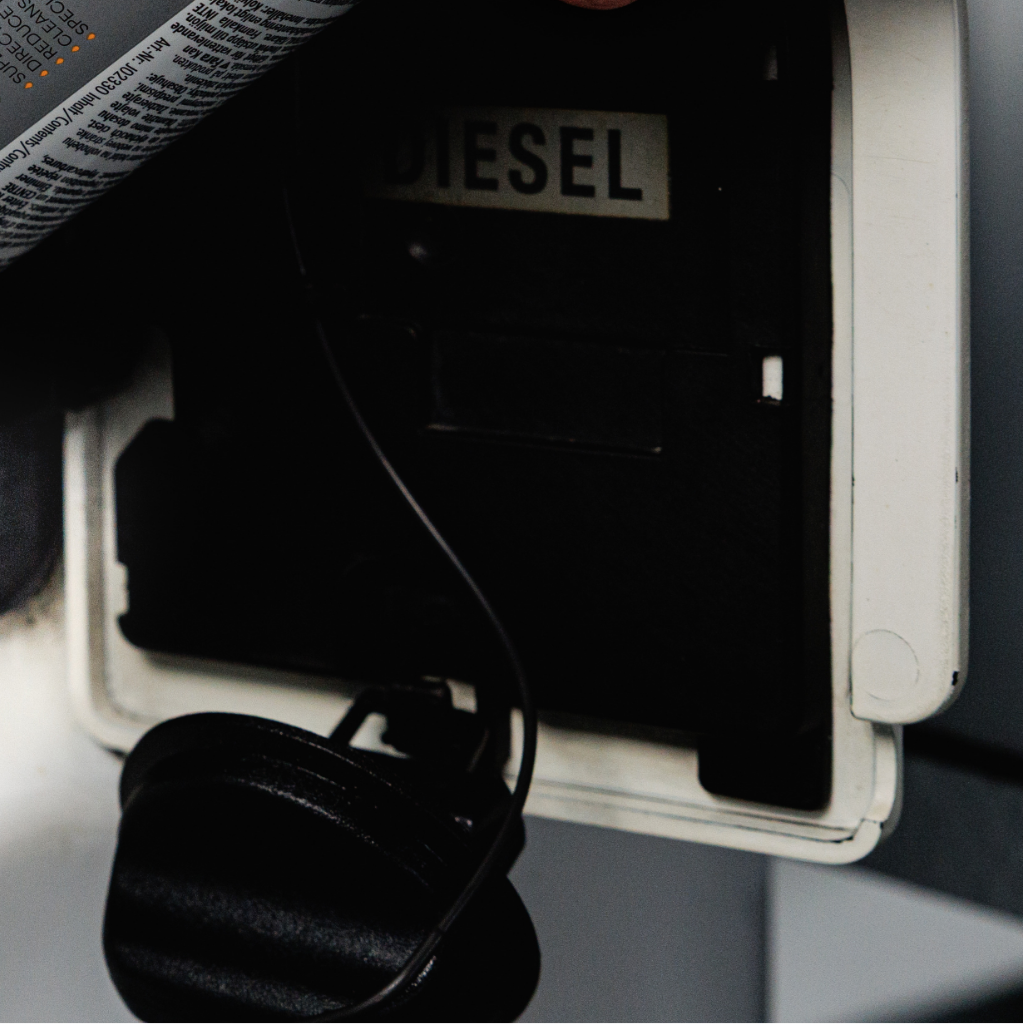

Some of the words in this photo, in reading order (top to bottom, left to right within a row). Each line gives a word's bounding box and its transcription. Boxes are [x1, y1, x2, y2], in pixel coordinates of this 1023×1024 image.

[190, 1, 219, 21] INTE
[230, 6, 263, 25] enligt
[177, 11, 218, 35] miljön.
[214, 15, 262, 40] Framkalla
[165, 20, 234, 58] vattenlevande
[209, 28, 230, 41] till
[179, 44, 203, 60] Kan
[196, 52, 225, 68] Fara
[166, 53, 215, 76] produkten.
[130, 80, 181, 104] predpismi.
[142, 70, 189, 95] Obsahuje:
[106, 98, 143, 118] volajte
[119, 89, 170, 114] Zozbierajte
[83, 118, 112, 134] ciest.
[94, 109, 132, 128] dosahu
[382, 119, 643, 202] DIESEL
[0, 180, 38, 200] CENTRE
